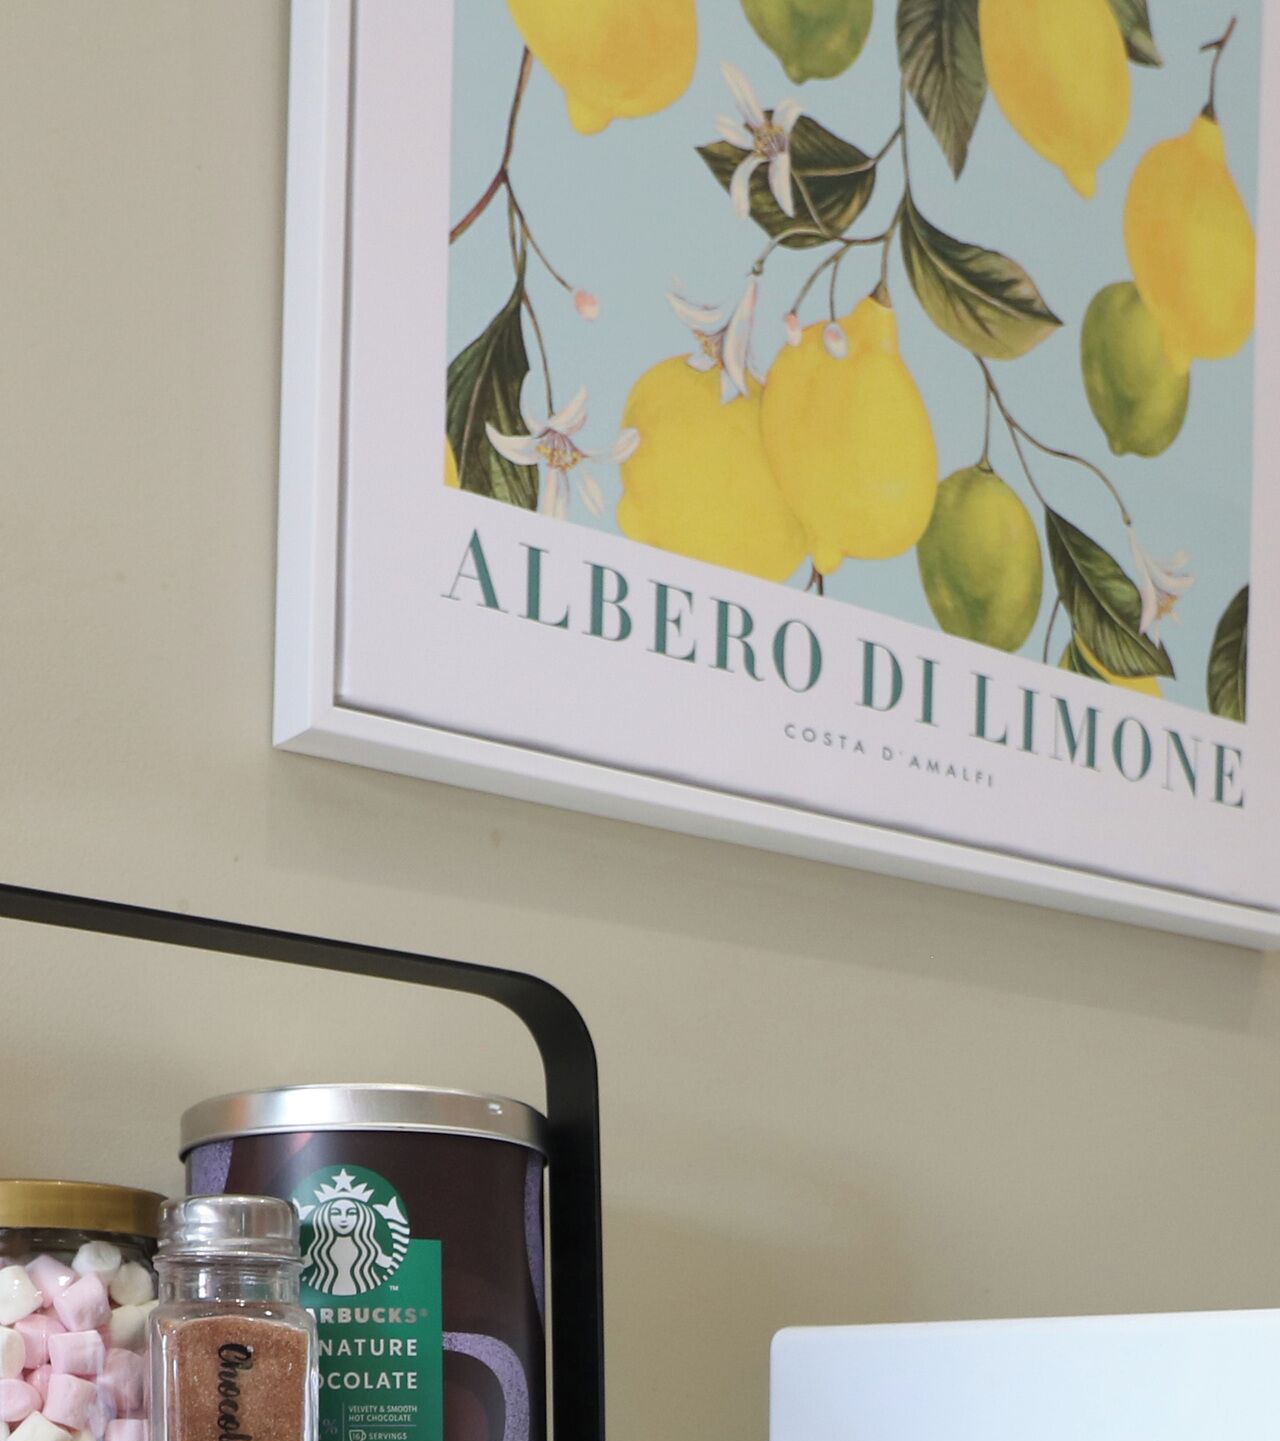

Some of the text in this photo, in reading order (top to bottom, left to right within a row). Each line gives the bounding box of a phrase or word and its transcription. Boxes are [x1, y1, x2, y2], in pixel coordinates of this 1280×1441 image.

[440, 528, 1246, 810] ALBERO DI LIMONE
[784, 724, 993, 787] COSTA D'AMALFI
[306, 1308, 417, 1324] RBUCKS
[319, 1339, 417, 1357] NATURE
[348, 1405, 377, 1413] VELVETY
[386, 1404, 417, 1413] SMOOTH
[348, 1413, 412, 1422] HOT CHOCOLATE
[368, 1432, 407, 1440] SERVINGS
